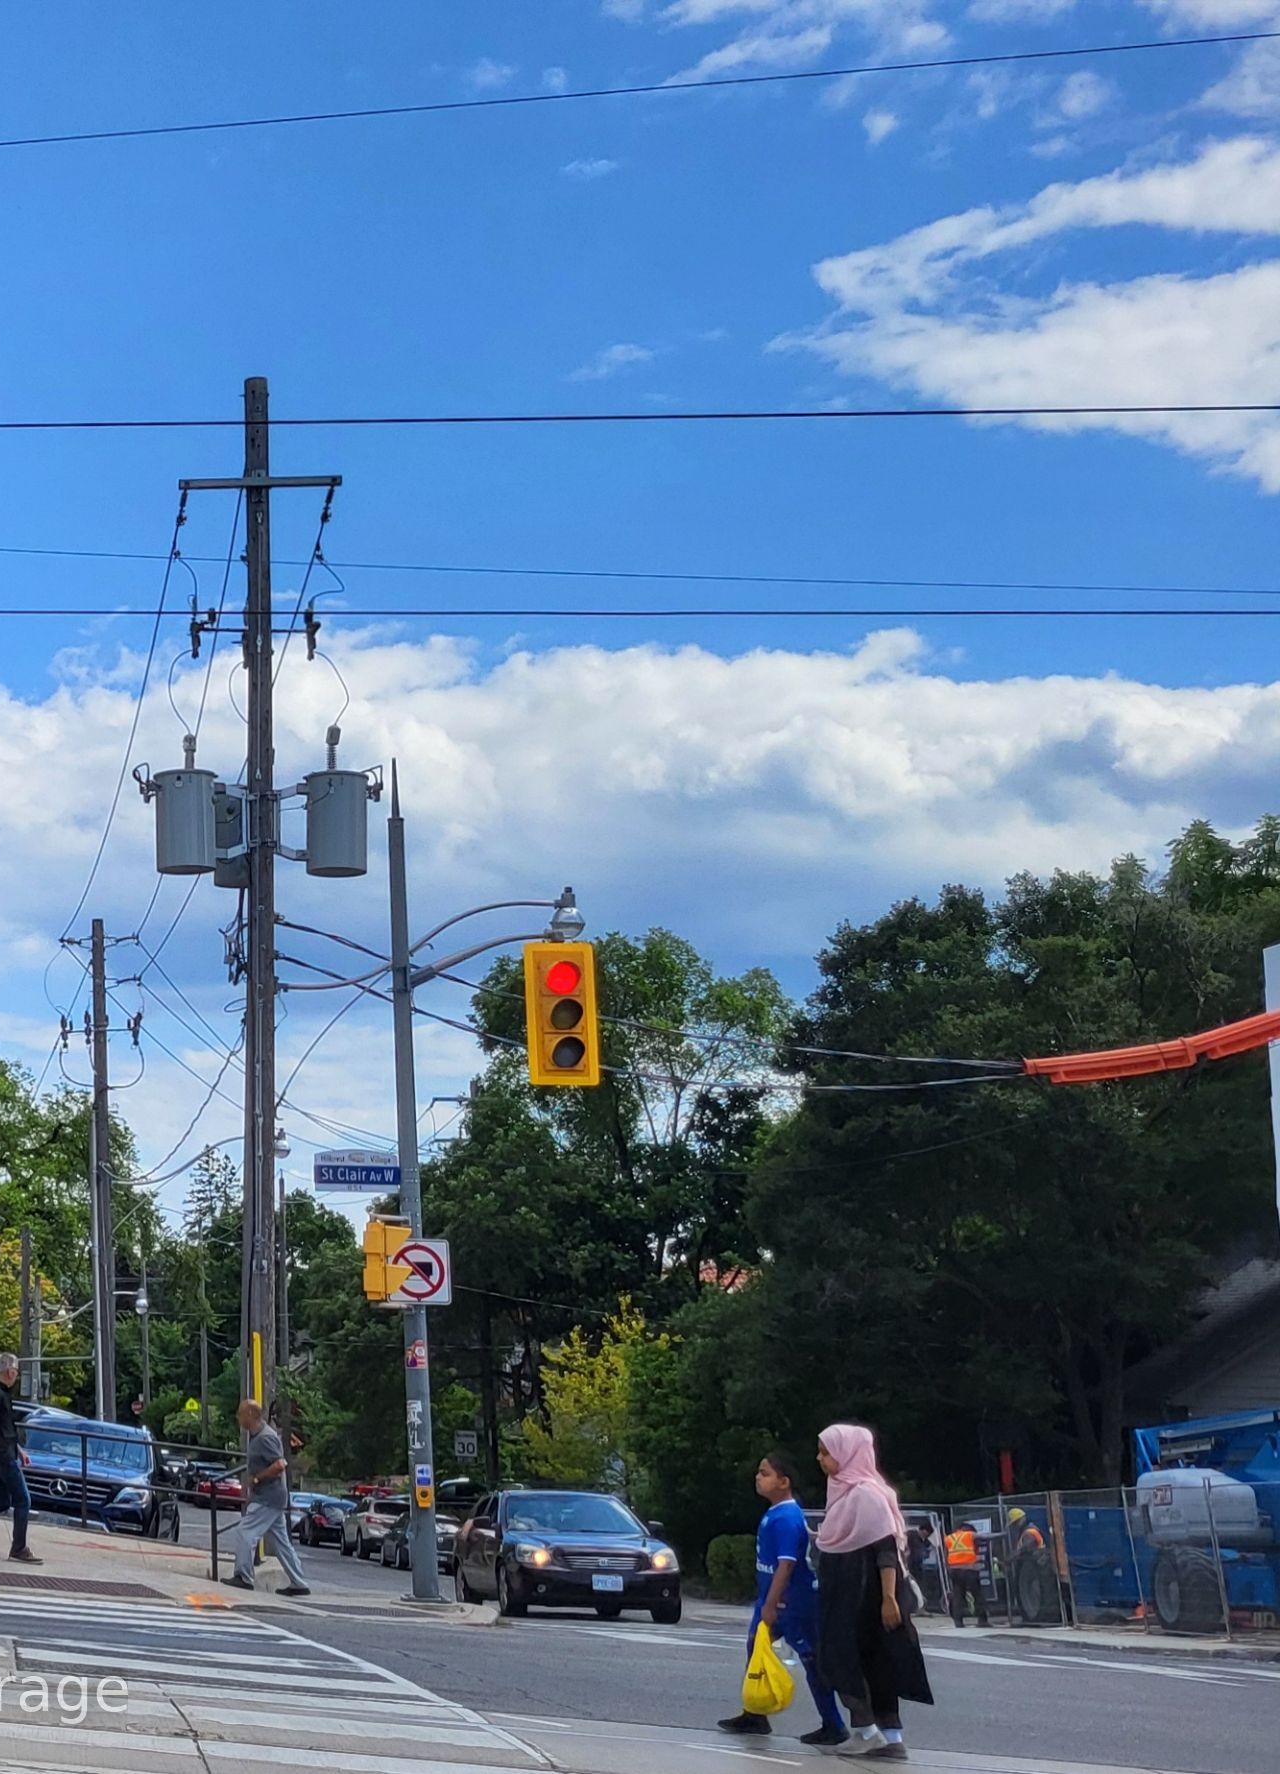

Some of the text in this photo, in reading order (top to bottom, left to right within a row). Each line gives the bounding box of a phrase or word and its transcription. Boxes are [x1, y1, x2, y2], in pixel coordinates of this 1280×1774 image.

[321, 1167, 394, 1182] St Clair Av W
[457, 1441, 475, 1455] 30
